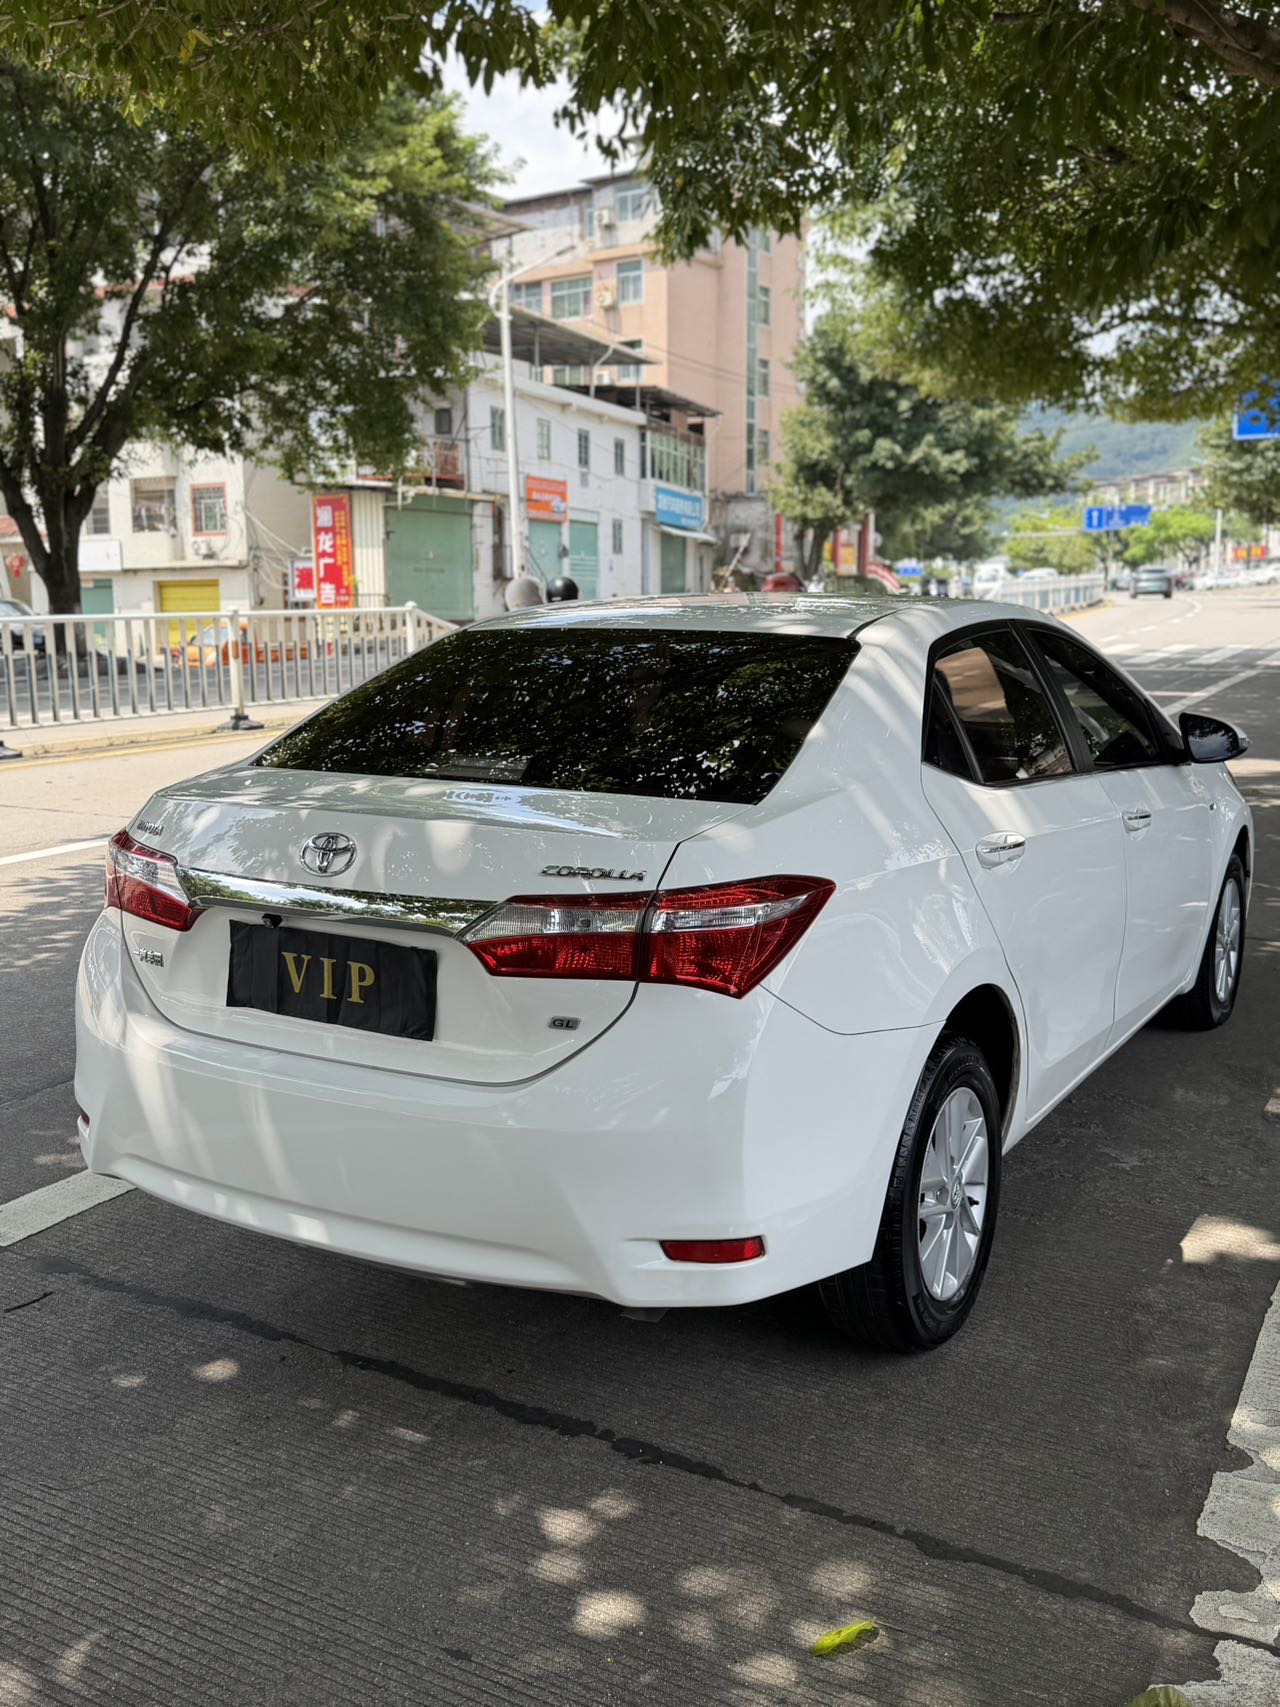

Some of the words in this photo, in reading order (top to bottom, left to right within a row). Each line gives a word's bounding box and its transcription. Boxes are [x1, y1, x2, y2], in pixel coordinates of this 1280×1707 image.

[540, 865, 647, 881] COROLLA
[282, 951, 376, 1004] VIP
[551, 1018, 576, 1029] GL
